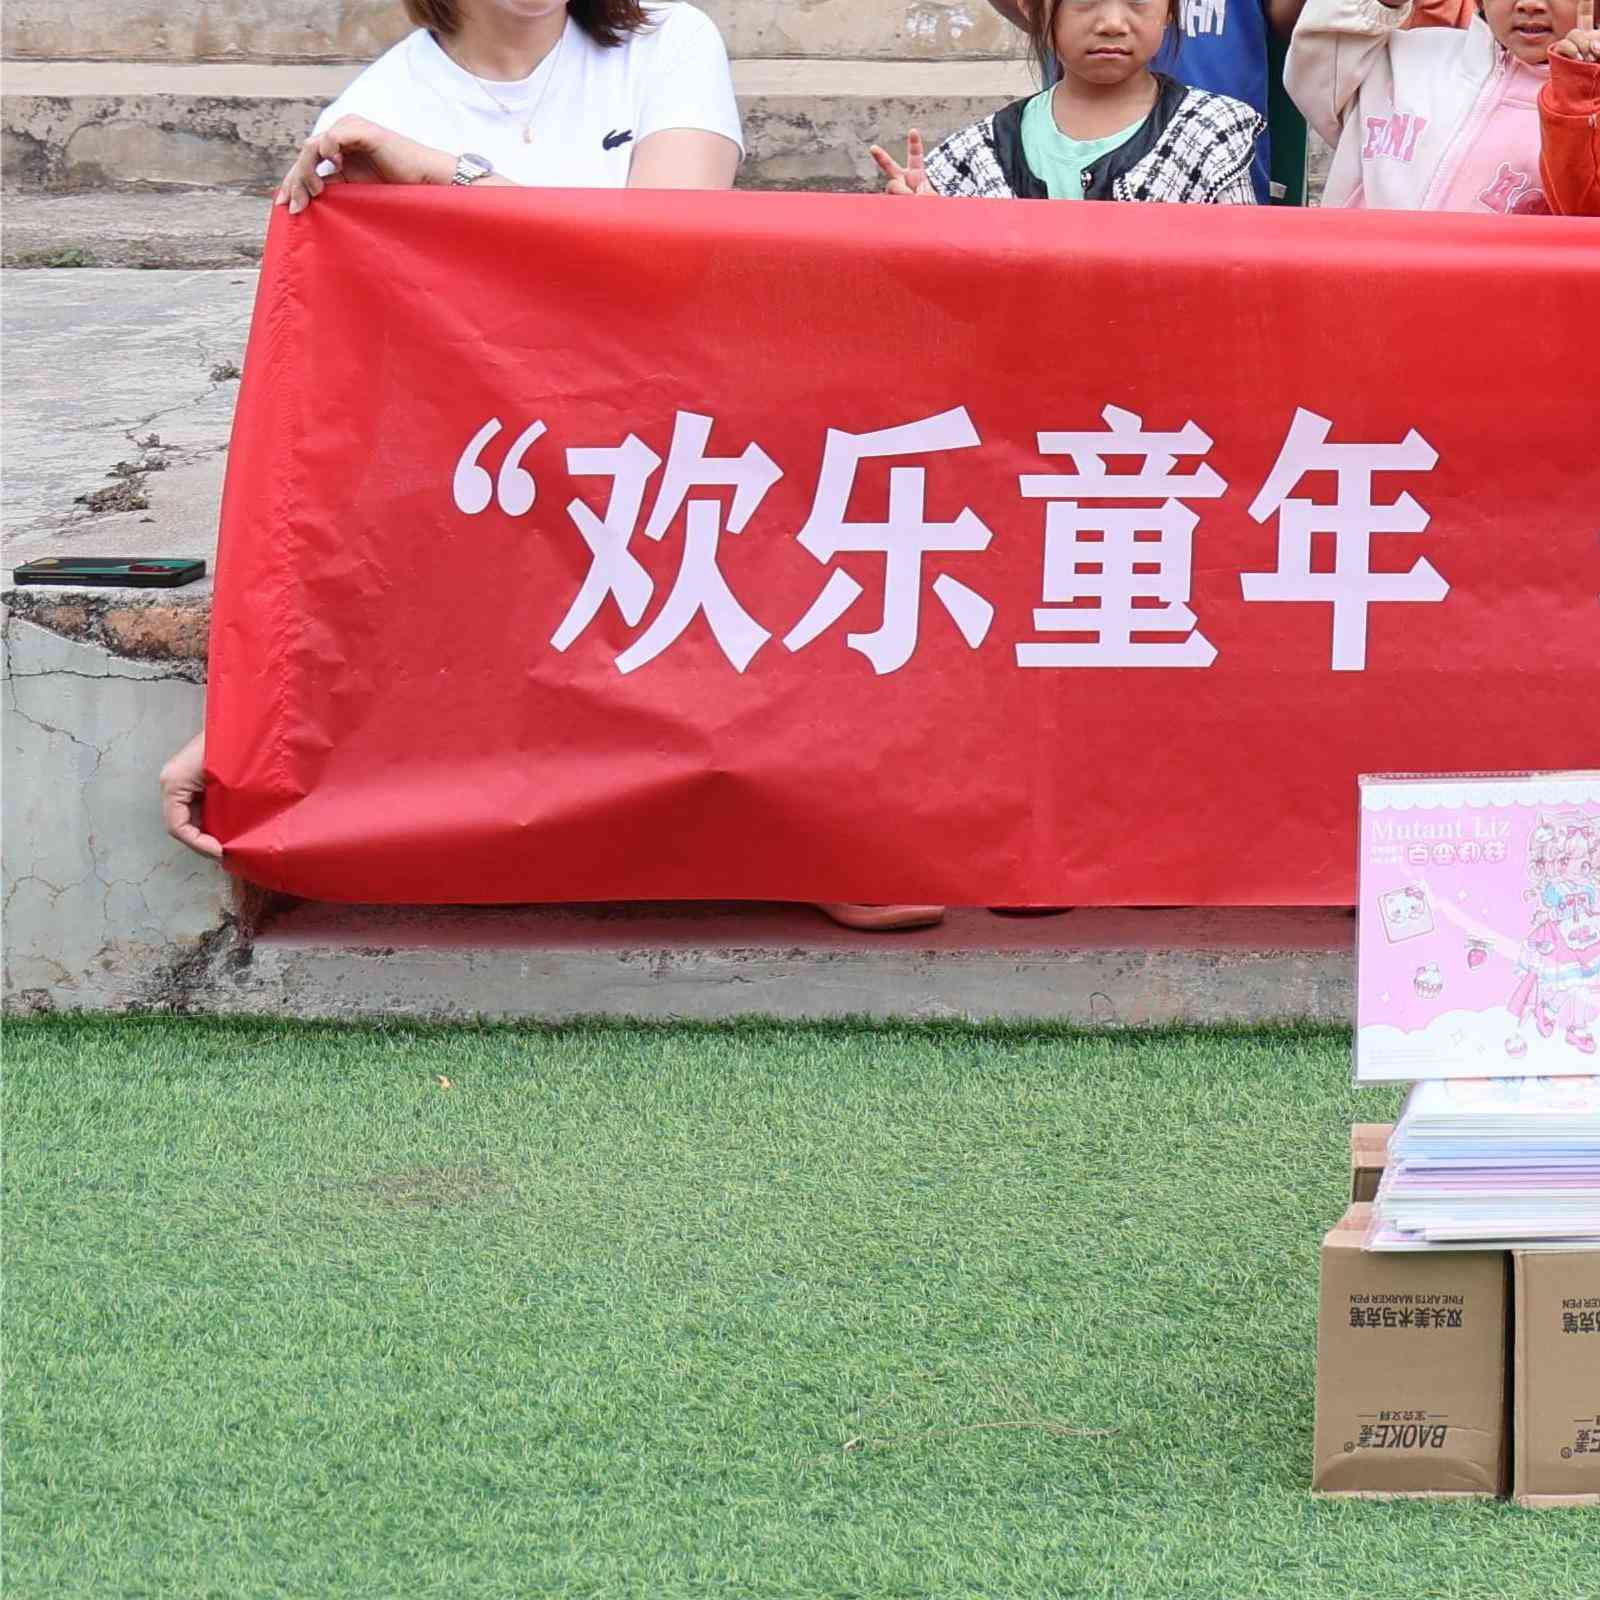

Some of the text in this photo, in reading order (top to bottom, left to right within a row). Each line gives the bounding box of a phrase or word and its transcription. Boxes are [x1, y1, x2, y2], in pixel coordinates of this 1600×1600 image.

[452, 404, 1451, 676] “欢乐童年
[1371, 815, 1513, 842] Mutant Liz
[1350, 1294, 1463, 1304] FINE ARTS MARKER PEN
[1562, 1299, 1582, 1308] PEN
[1349, 1307, 1463, 1327] 双头美术马克笔
[1380, 1411, 1426, 1421] 宝克文具
[1373, 1424, 1448, 1448] BAOKE
